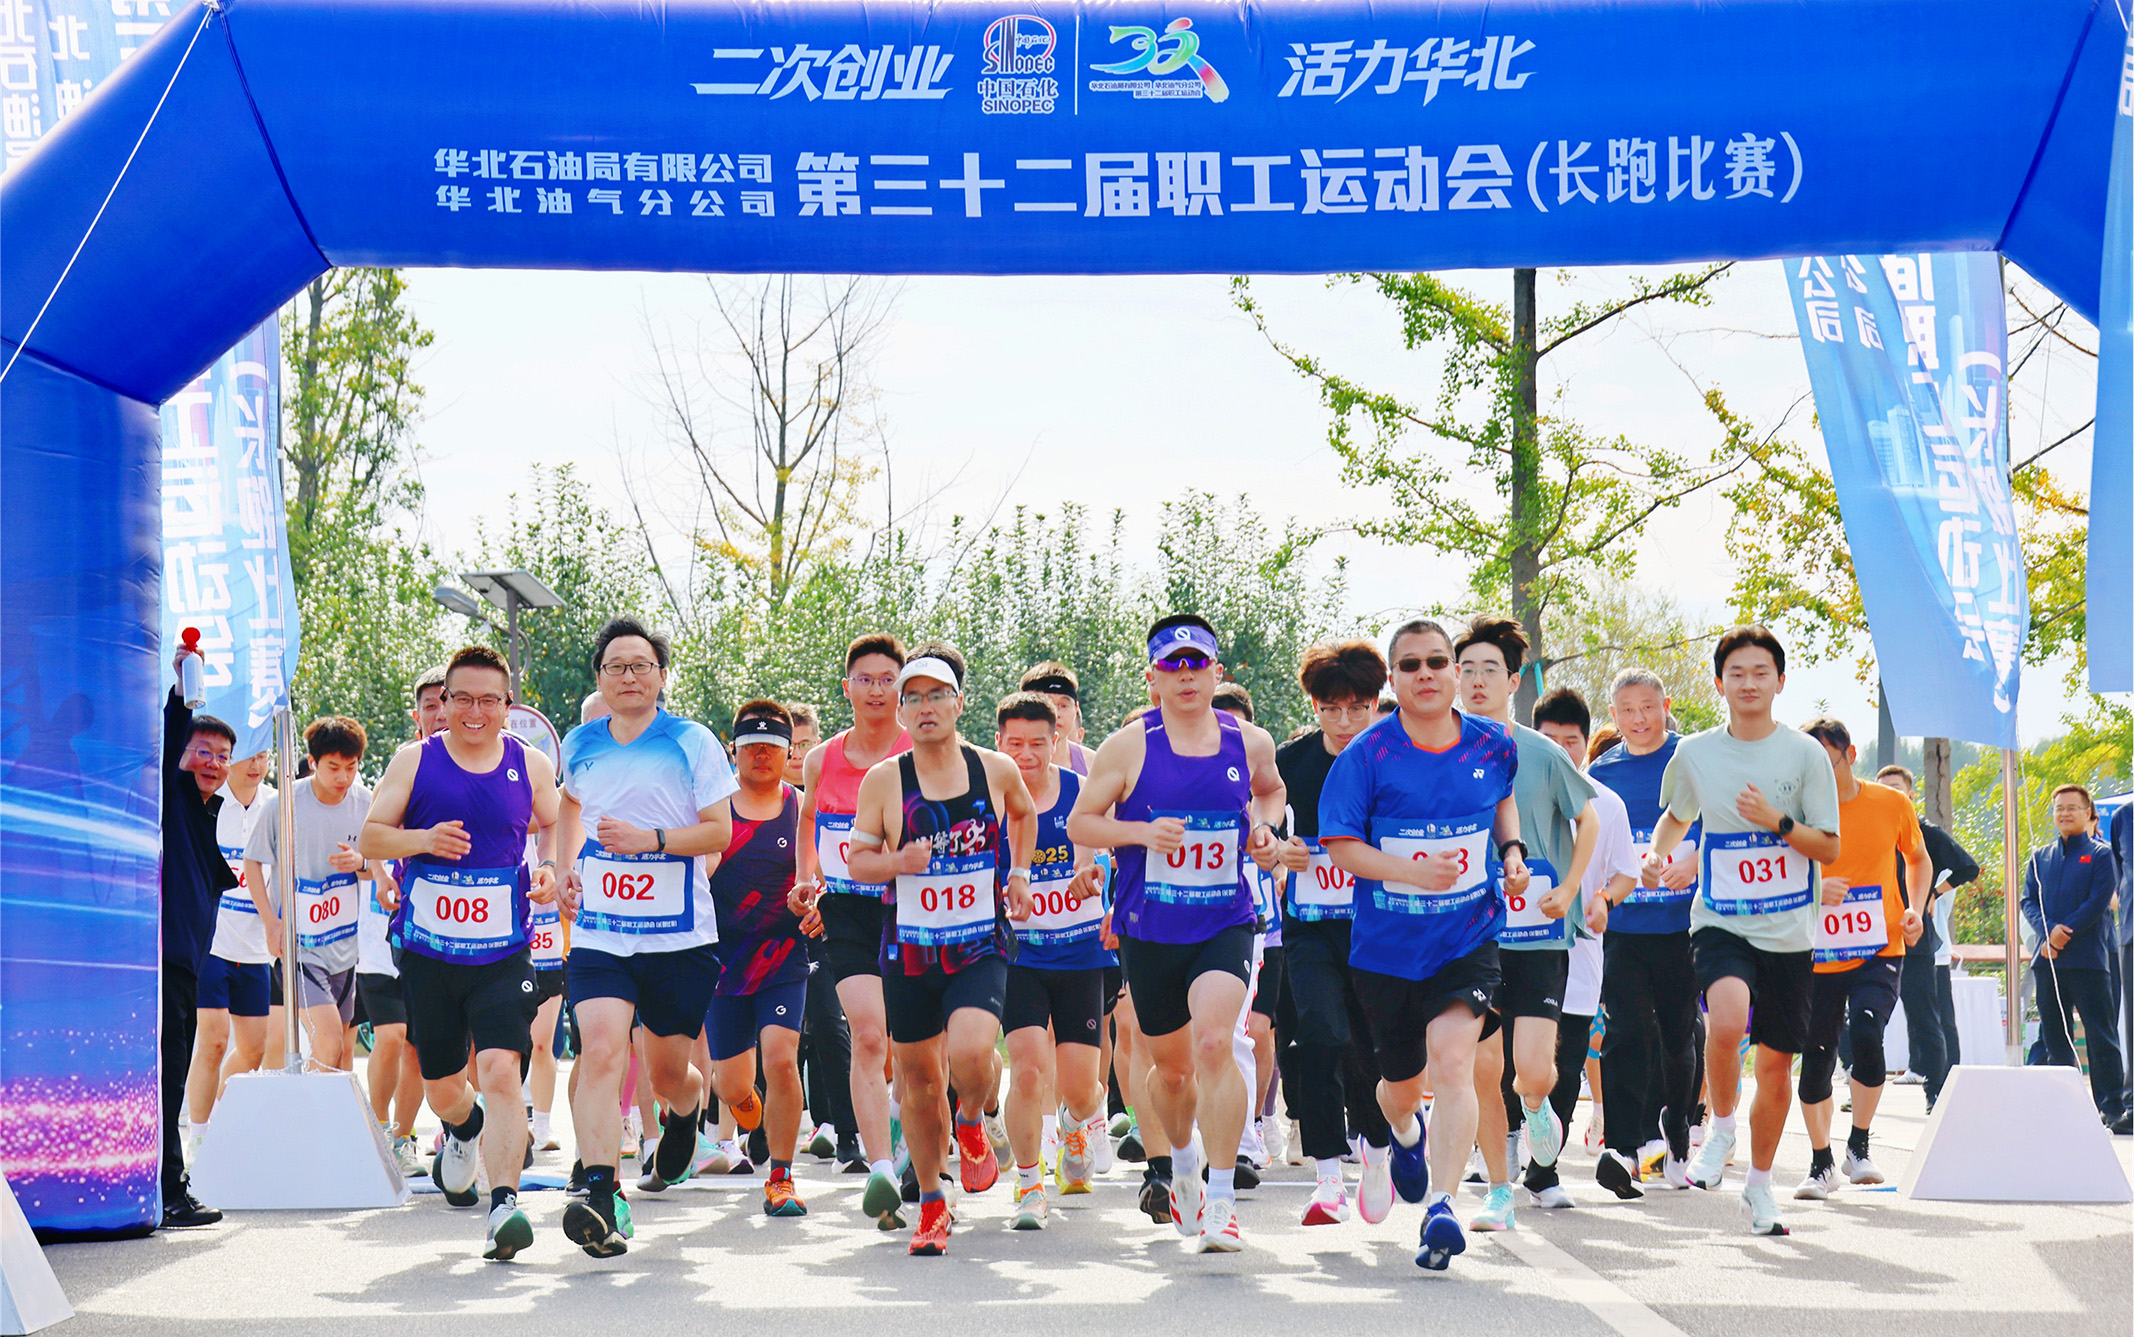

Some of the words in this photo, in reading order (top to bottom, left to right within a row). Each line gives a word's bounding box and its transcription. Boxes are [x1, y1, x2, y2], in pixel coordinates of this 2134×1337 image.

[689, 43, 955, 102] 二次创业
[1277, 35, 1538, 107] 活力华北
[978, 78, 1059, 99] 中国石化
[982, 98, 1055, 114] SINOPEC
[433, 148, 773, 183] 华北石油局有限公司
[435, 185, 776, 217] 华北油气分公司
[1167, 842, 1225, 869] 013
[1738, 854, 1787, 884] 031
[602, 872, 655, 900] 062
[920, 884, 976, 912] 018
[309, 896, 340, 923] 080
[436, 895, 489, 923] 008
[1031, 890, 1083, 917] 006
[1824, 910, 1872, 935] 019
